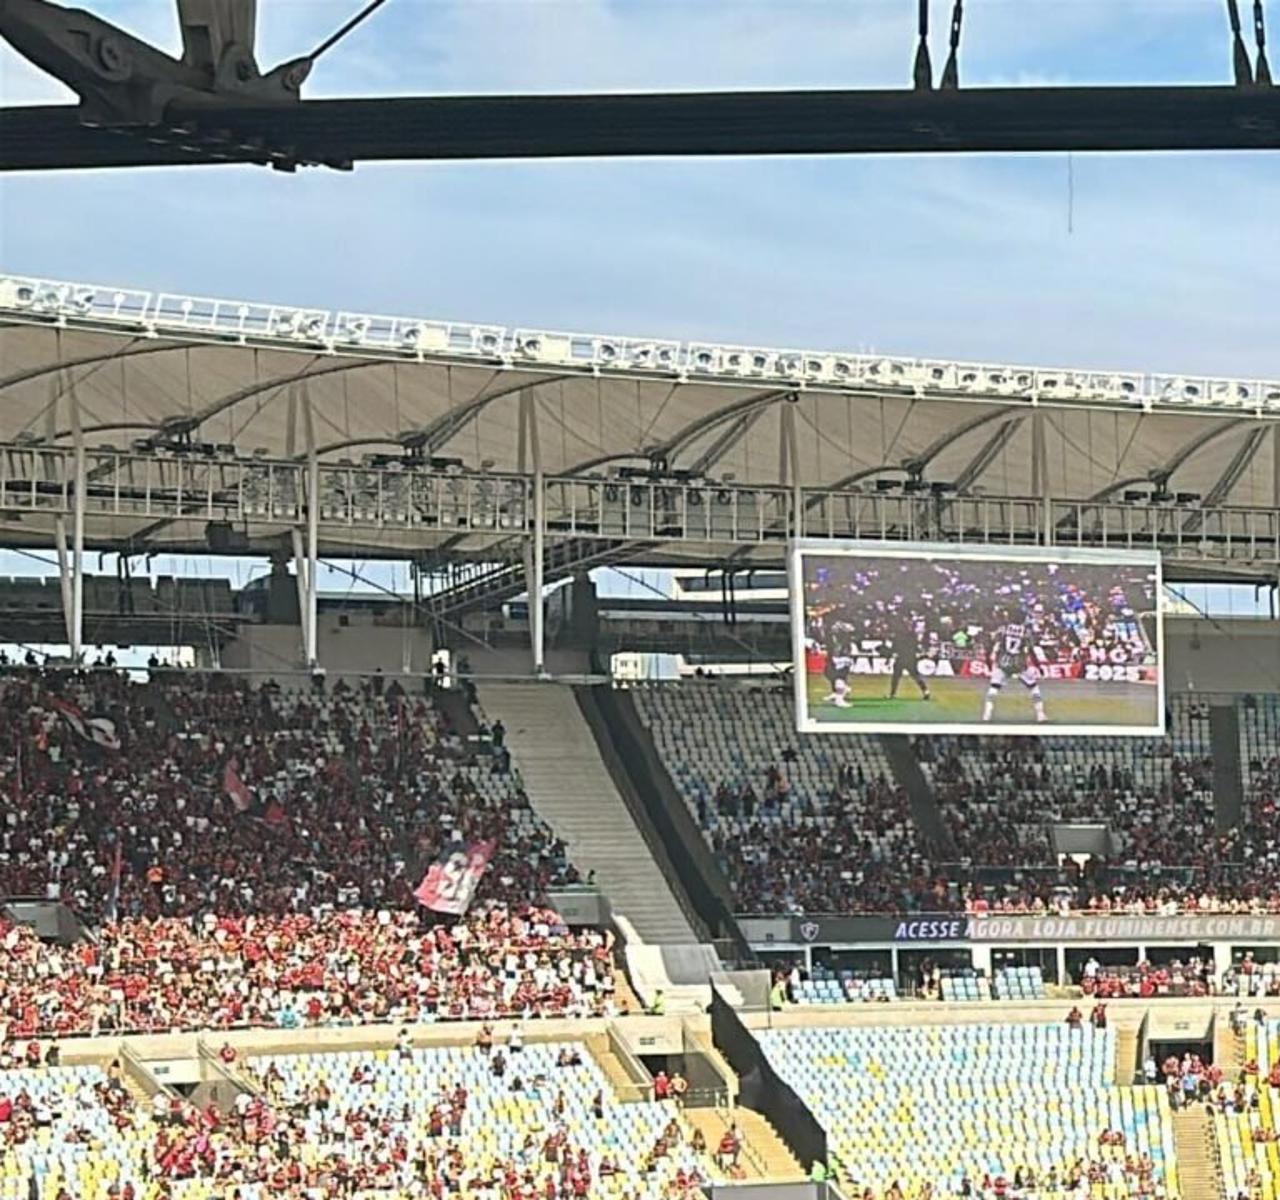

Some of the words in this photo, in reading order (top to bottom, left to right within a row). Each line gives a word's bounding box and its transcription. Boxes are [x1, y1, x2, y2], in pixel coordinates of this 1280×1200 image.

[896, 923, 959, 938] ACESSE
[965, 922, 1024, 937] AGORA
[1033, 921, 1275, 937] LOJA.FLUMINENSE.COM.BR
